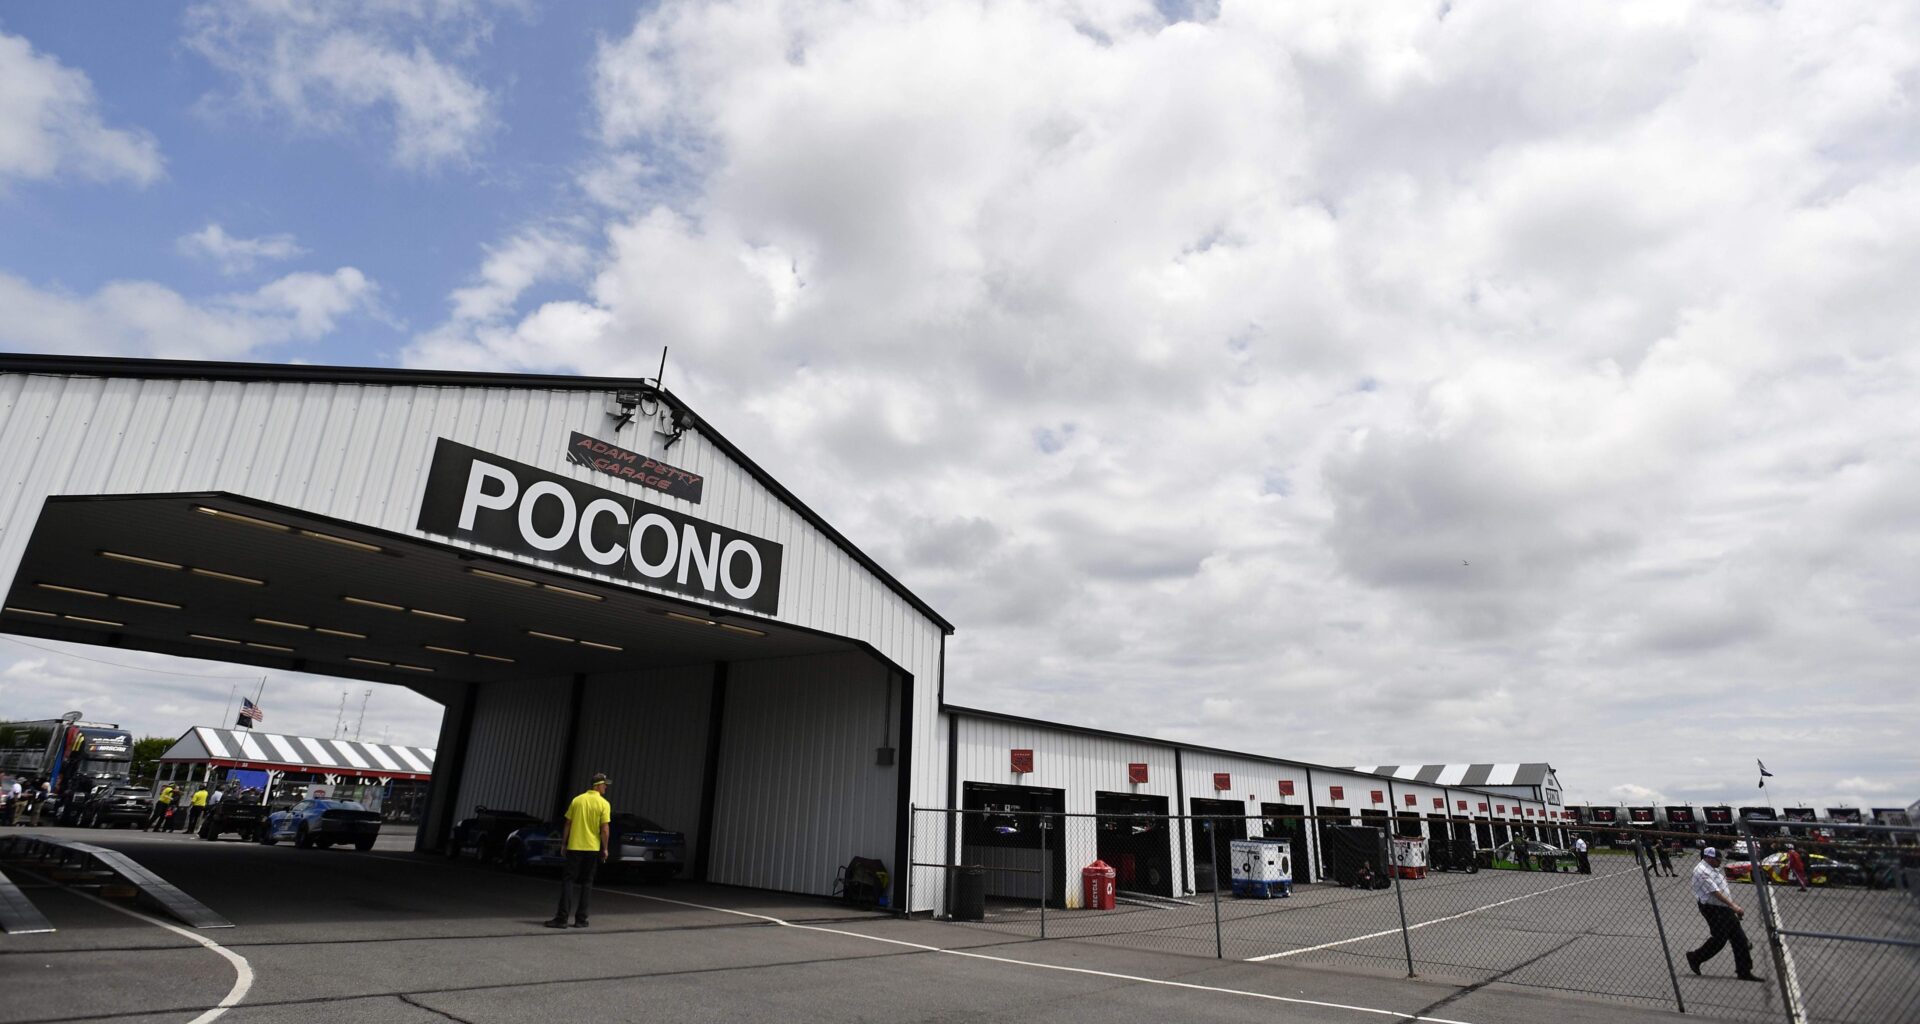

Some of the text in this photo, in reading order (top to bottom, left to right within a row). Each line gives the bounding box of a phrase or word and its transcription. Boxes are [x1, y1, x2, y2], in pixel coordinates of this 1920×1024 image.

[577, 439, 700, 484] ADAM PETTY
[595, 458, 672, 489] GARAGE
[458, 458, 762, 600] POCONO
